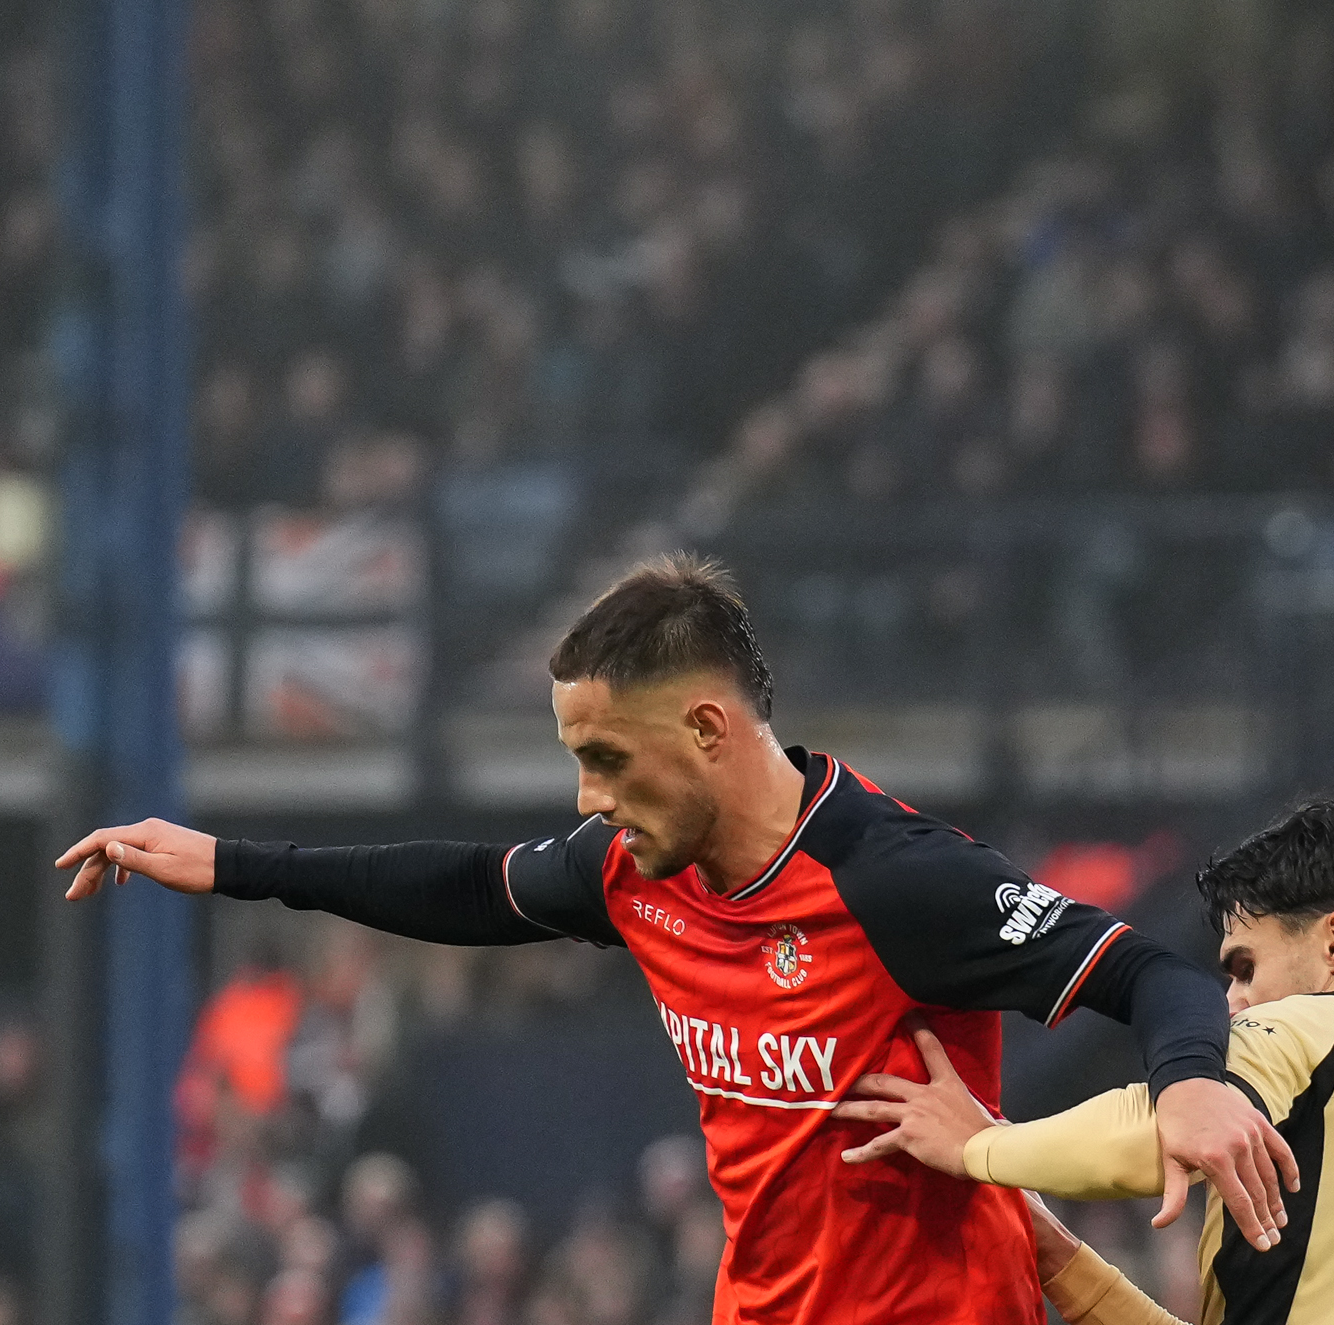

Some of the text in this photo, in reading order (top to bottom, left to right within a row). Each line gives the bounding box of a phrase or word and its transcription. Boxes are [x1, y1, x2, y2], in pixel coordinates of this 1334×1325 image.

[632, 899, 686, 936] REFLO
[788, 924, 808, 946] TOWN
[791, 968, 808, 987] CLUB
[653, 994, 837, 1093] APITAL SKY
